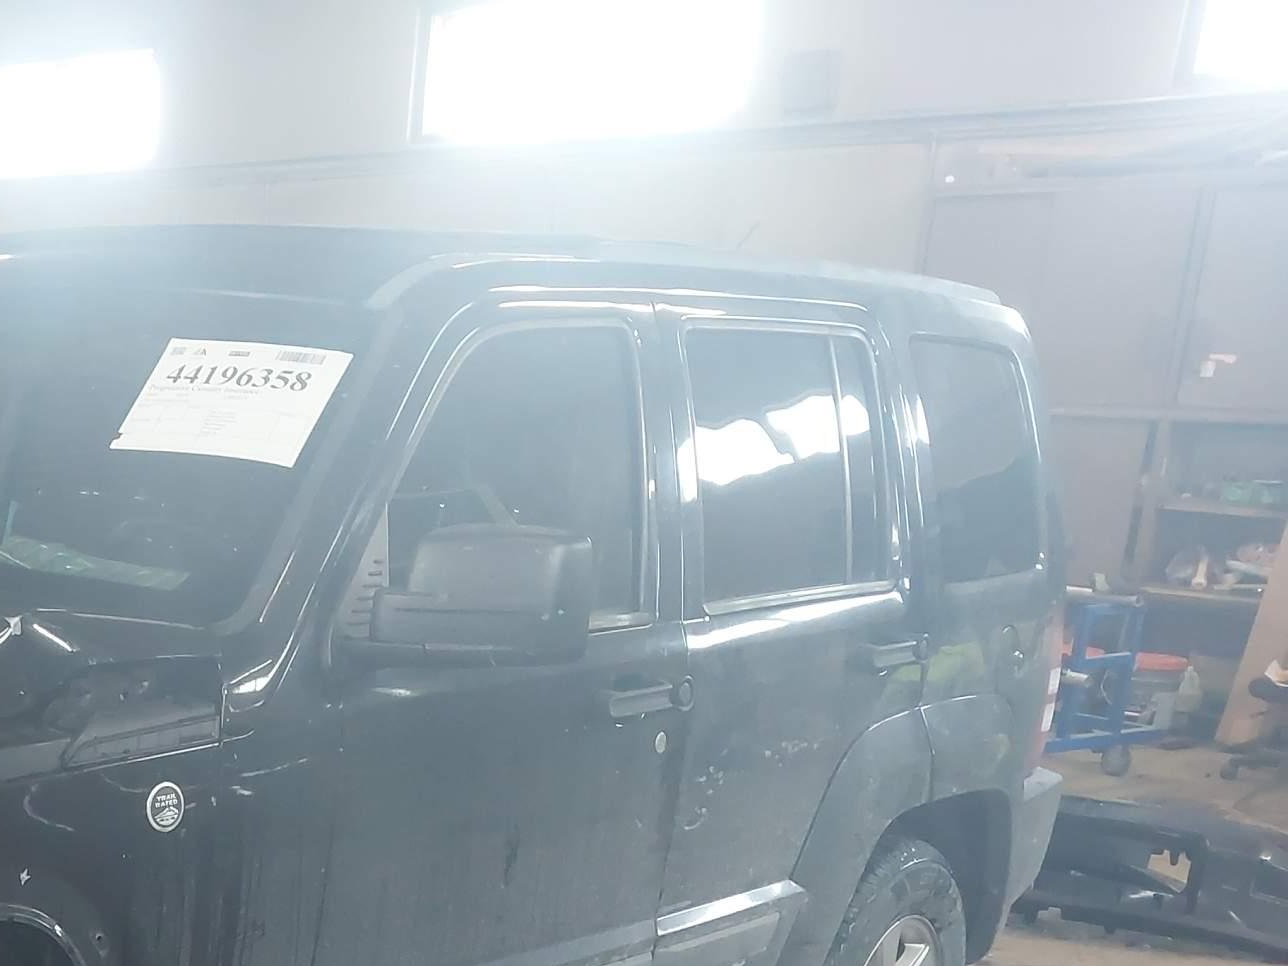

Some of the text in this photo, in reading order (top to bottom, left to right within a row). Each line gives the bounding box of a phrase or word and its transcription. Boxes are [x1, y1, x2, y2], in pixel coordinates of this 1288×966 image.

[165, 363, 313, 392] 44196358
[156, 792, 177, 803] TRAIL
[154, 798, 179, 809] RATED
